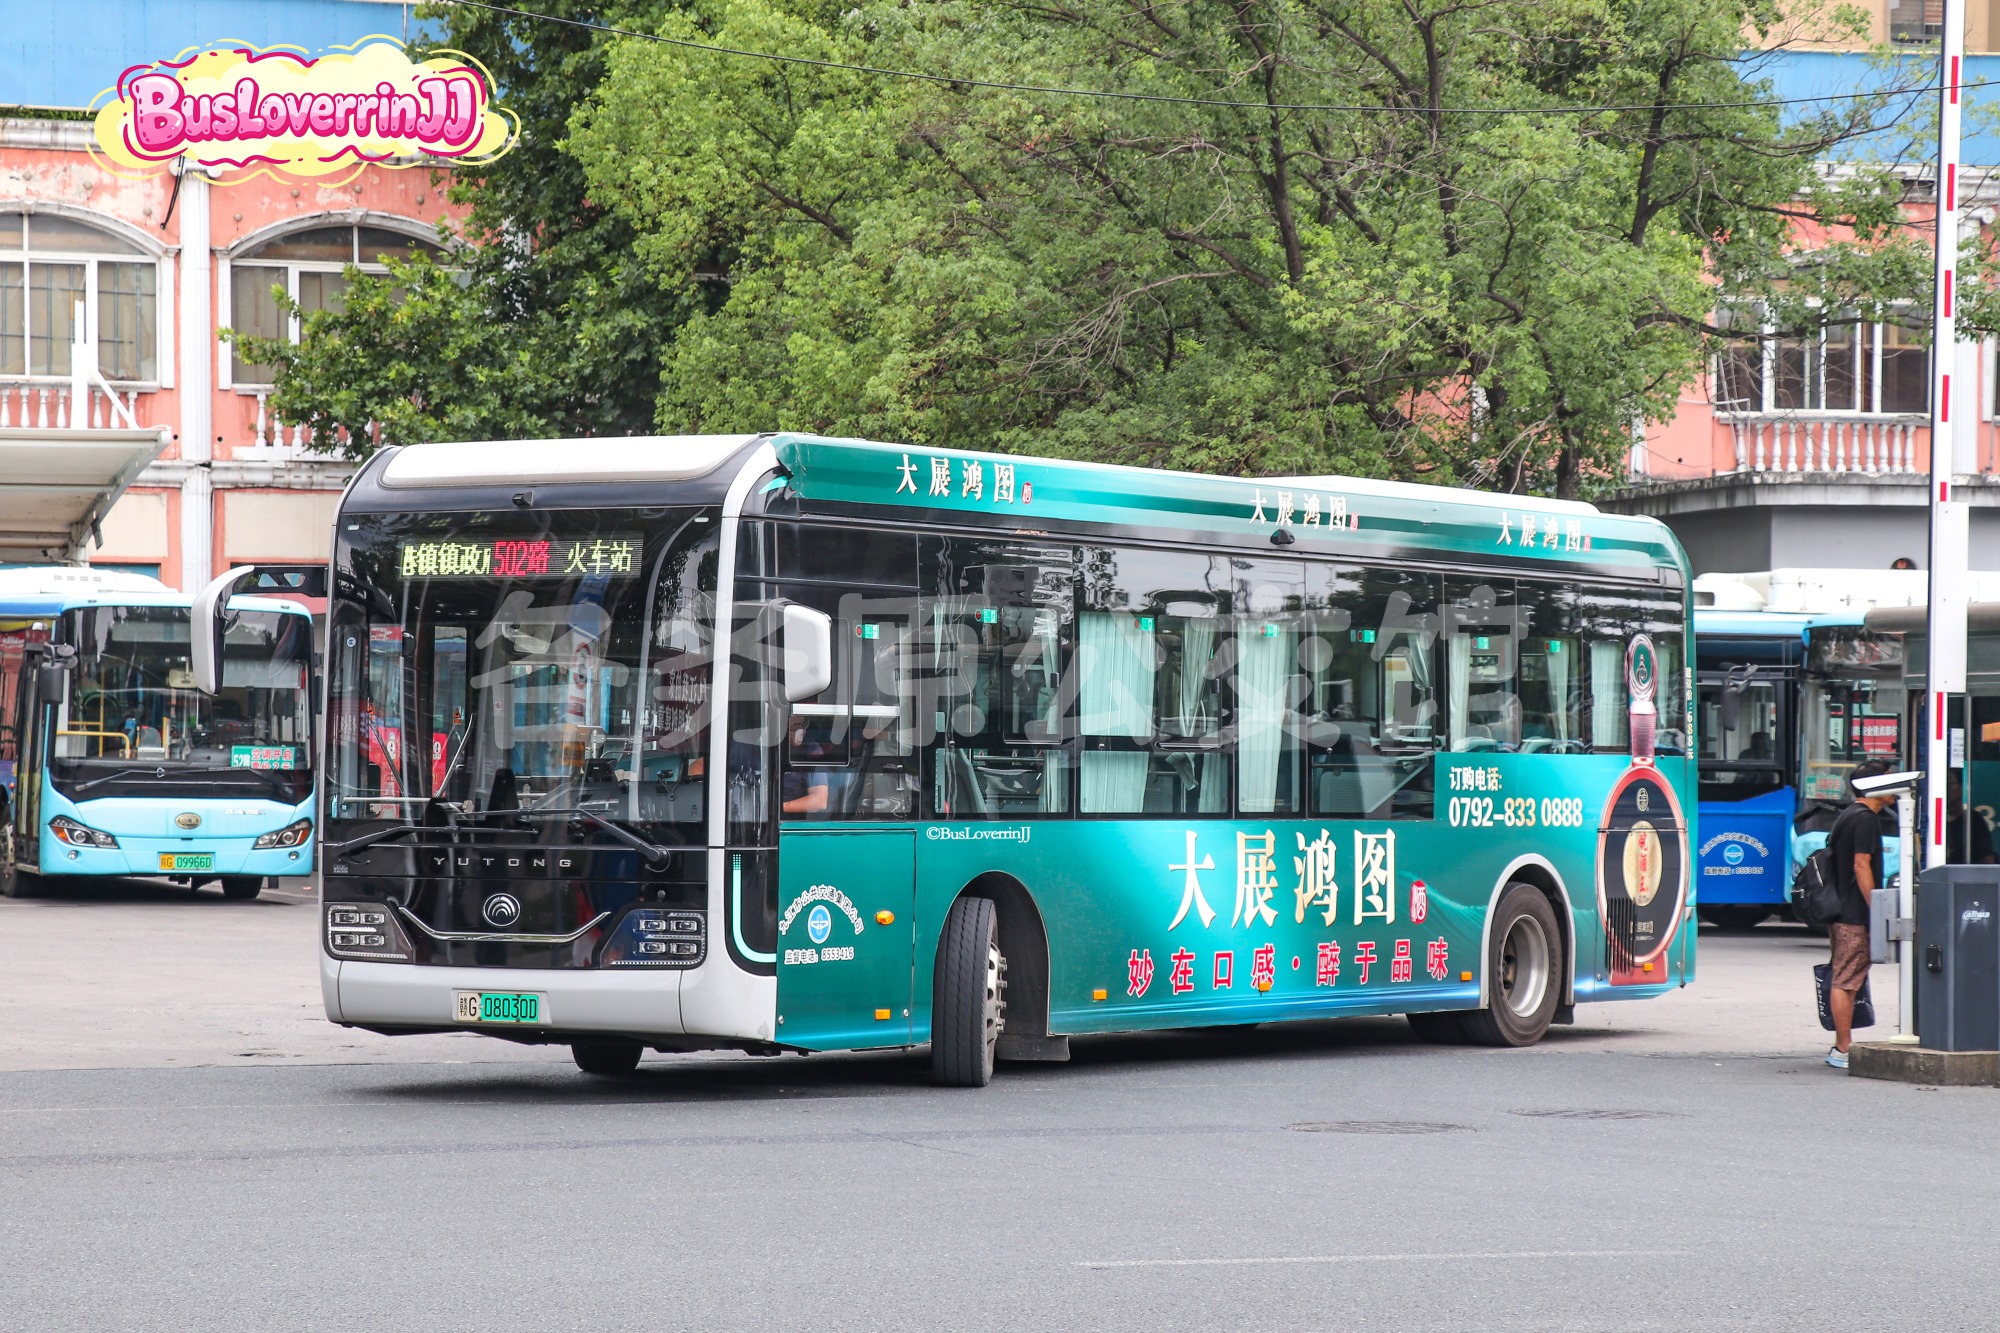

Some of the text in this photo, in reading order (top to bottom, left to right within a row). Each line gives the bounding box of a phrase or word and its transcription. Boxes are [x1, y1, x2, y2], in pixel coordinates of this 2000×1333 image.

[896, 453, 1015, 504] 大展鸿图
[1249, 488, 1347, 532] 大展鸿图
[1496, 511, 1582, 552] 大展鸿图
[493, 540, 550, 576] 502路
[564, 540, 633, 575] 火车站
[1449, 797, 1583, 827] 0792-833 0888
[434, 857, 572, 868] YUTONG
[1168, 828, 1397, 932] 大展鸿图
[779, 884, 865, 935] 九江市公共交通集团公司
[821, 946, 854, 961] 8553416
